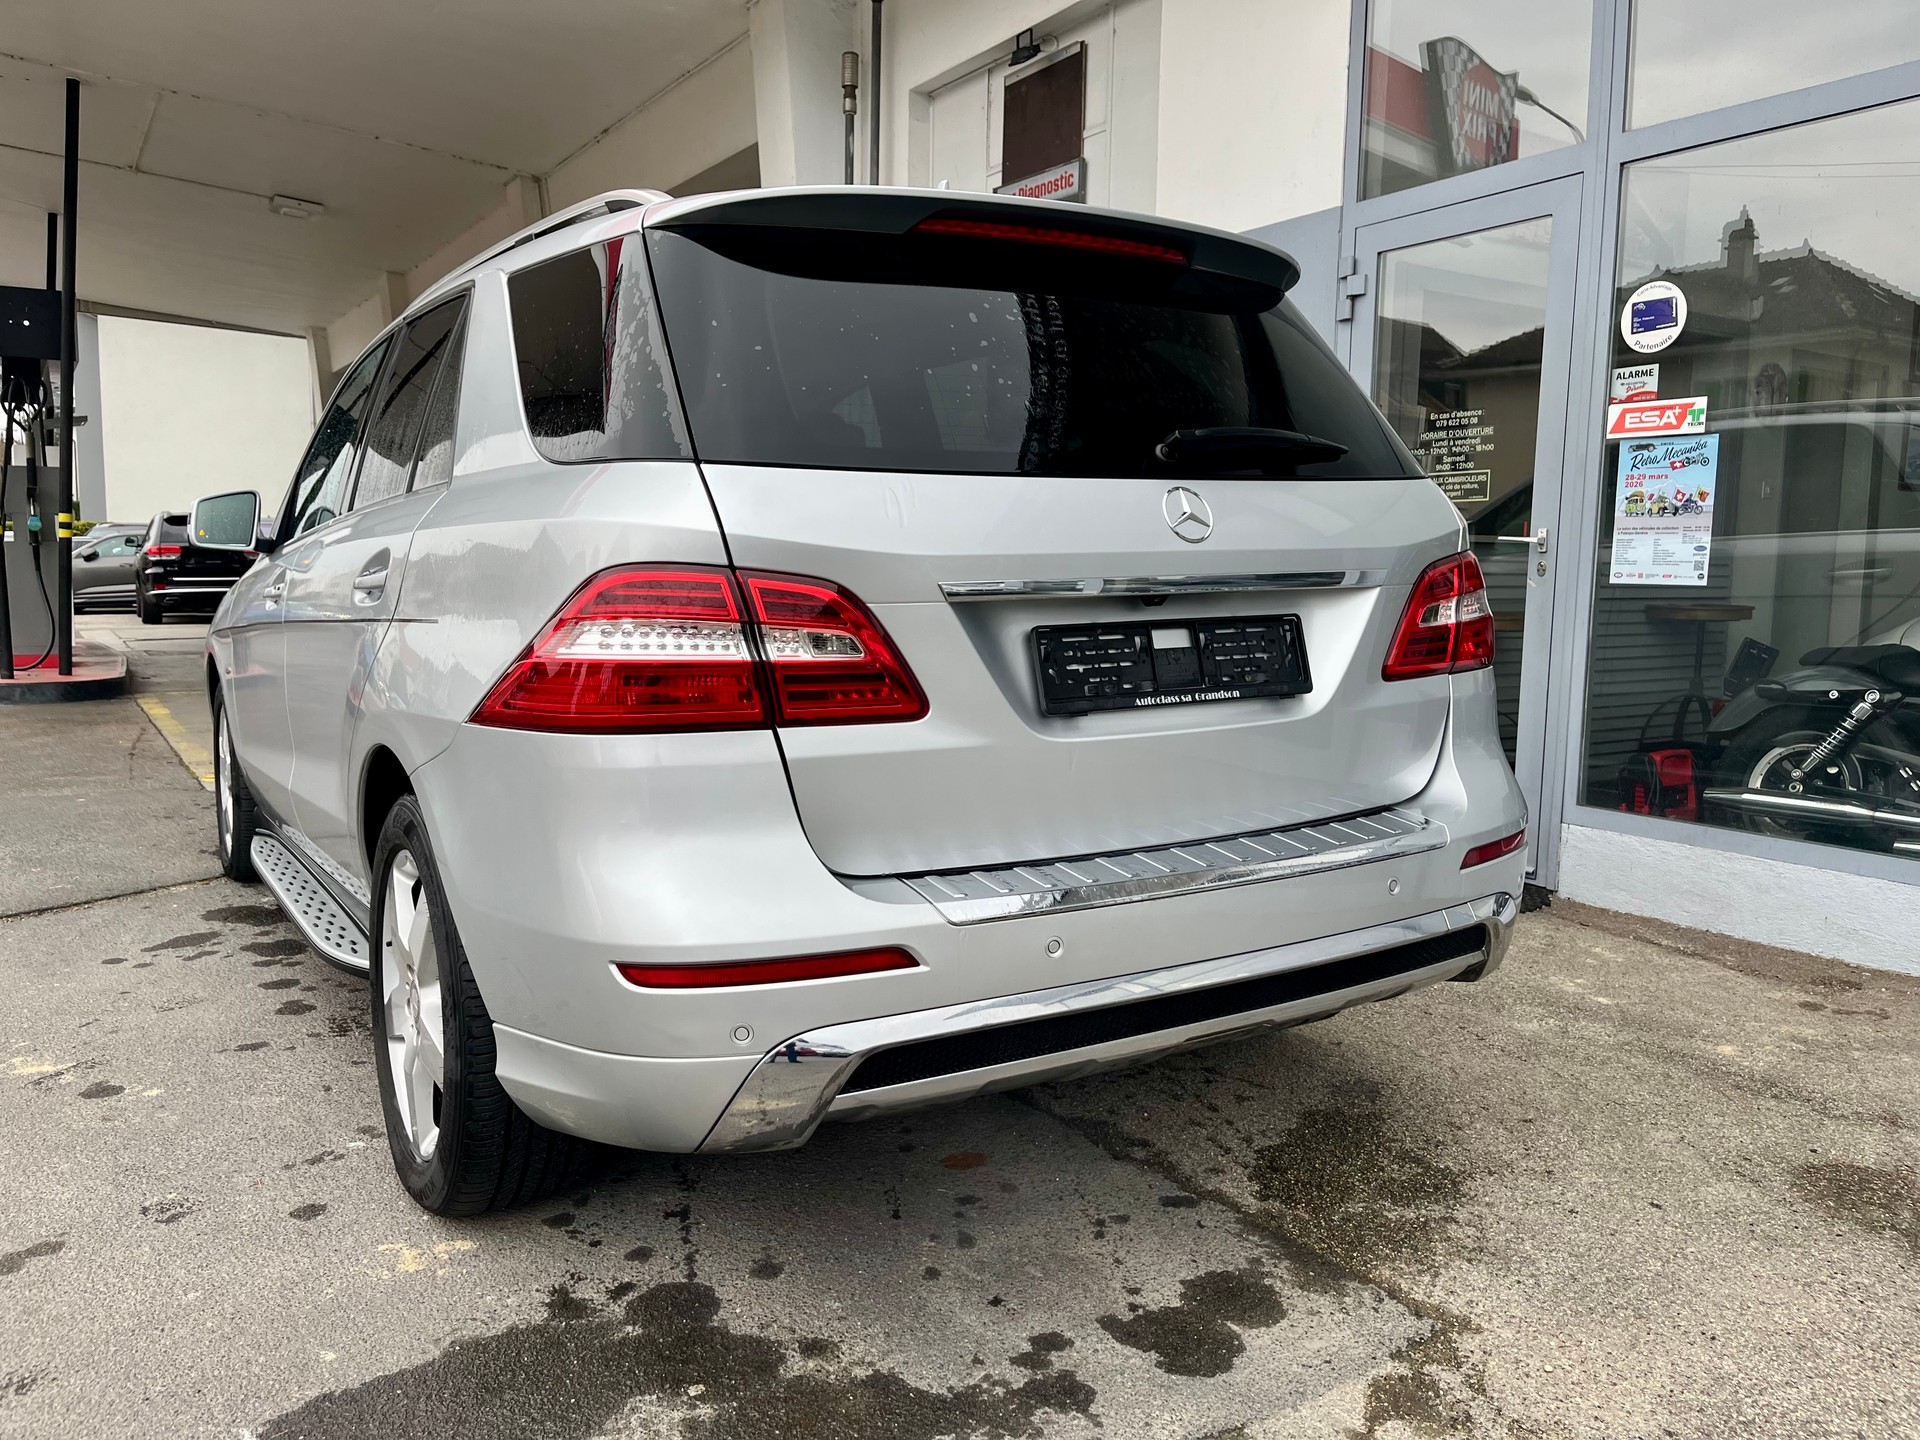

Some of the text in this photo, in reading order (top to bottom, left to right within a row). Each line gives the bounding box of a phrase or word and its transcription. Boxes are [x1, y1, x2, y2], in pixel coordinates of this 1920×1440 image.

[1018, 171, 1074, 199] Diagnostic
[1633, 334, 1673, 351] Partenaire
[1615, 368, 1655, 381] ALARME
[1430, 412, 1438, 420] En
[1435, 419, 1448, 427] 079
[1448, 418, 1460, 426] 622
[1420, 426, 1494, 440] HORAIRE D'OUVERTURE
[1432, 439, 1448, 447] Lundi
[1455, 436, 1482, 445] vendredi
[1430, 447, 1448, 455] 12h00
[1442, 455, 1466, 463] Samedi
[1455, 461, 1475, 469] 12h00
[1444, 474, 1487, 484] CAMBRIOLEURS
[1625, 473, 1646, 481] 28-29
[1134, 692, 1181, 707] Autoclass
[1195, 689, 1240, 702] Grandson
